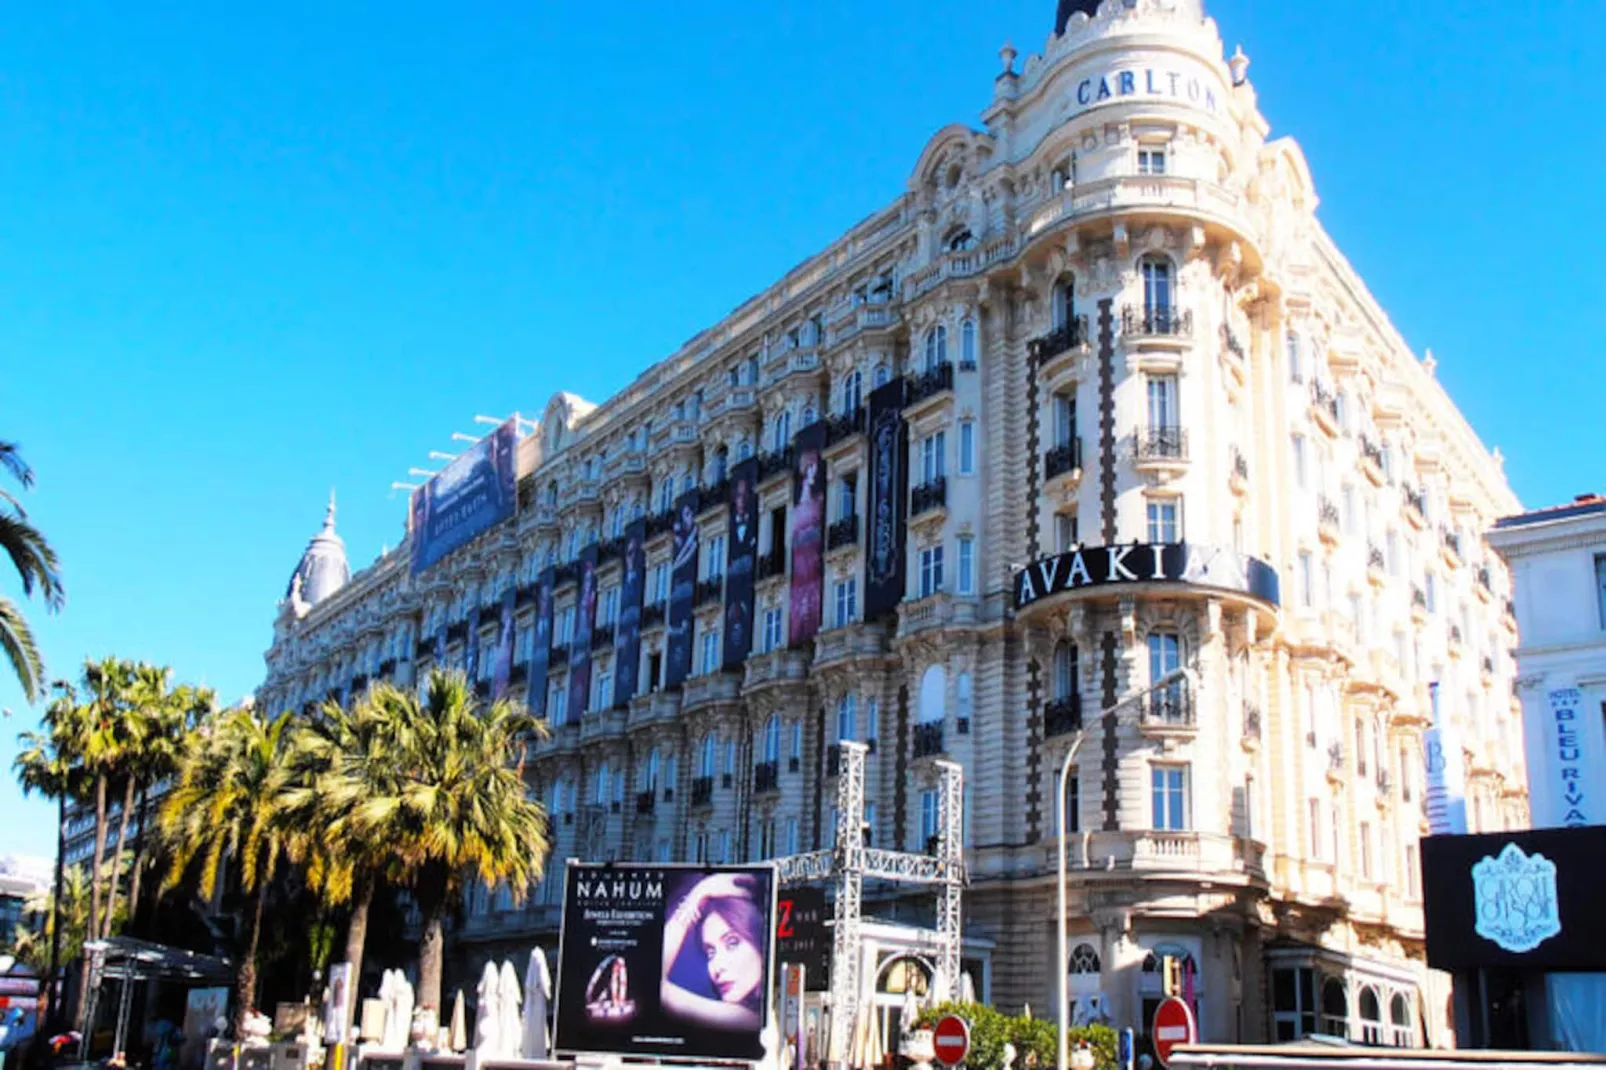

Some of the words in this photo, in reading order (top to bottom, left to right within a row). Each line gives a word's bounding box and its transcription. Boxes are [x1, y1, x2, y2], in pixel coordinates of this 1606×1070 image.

[1076, 68, 1217, 112] CARLTON
[1561, 767, 1588, 827] RIVA
[576, 880, 663, 900] NAHUM
